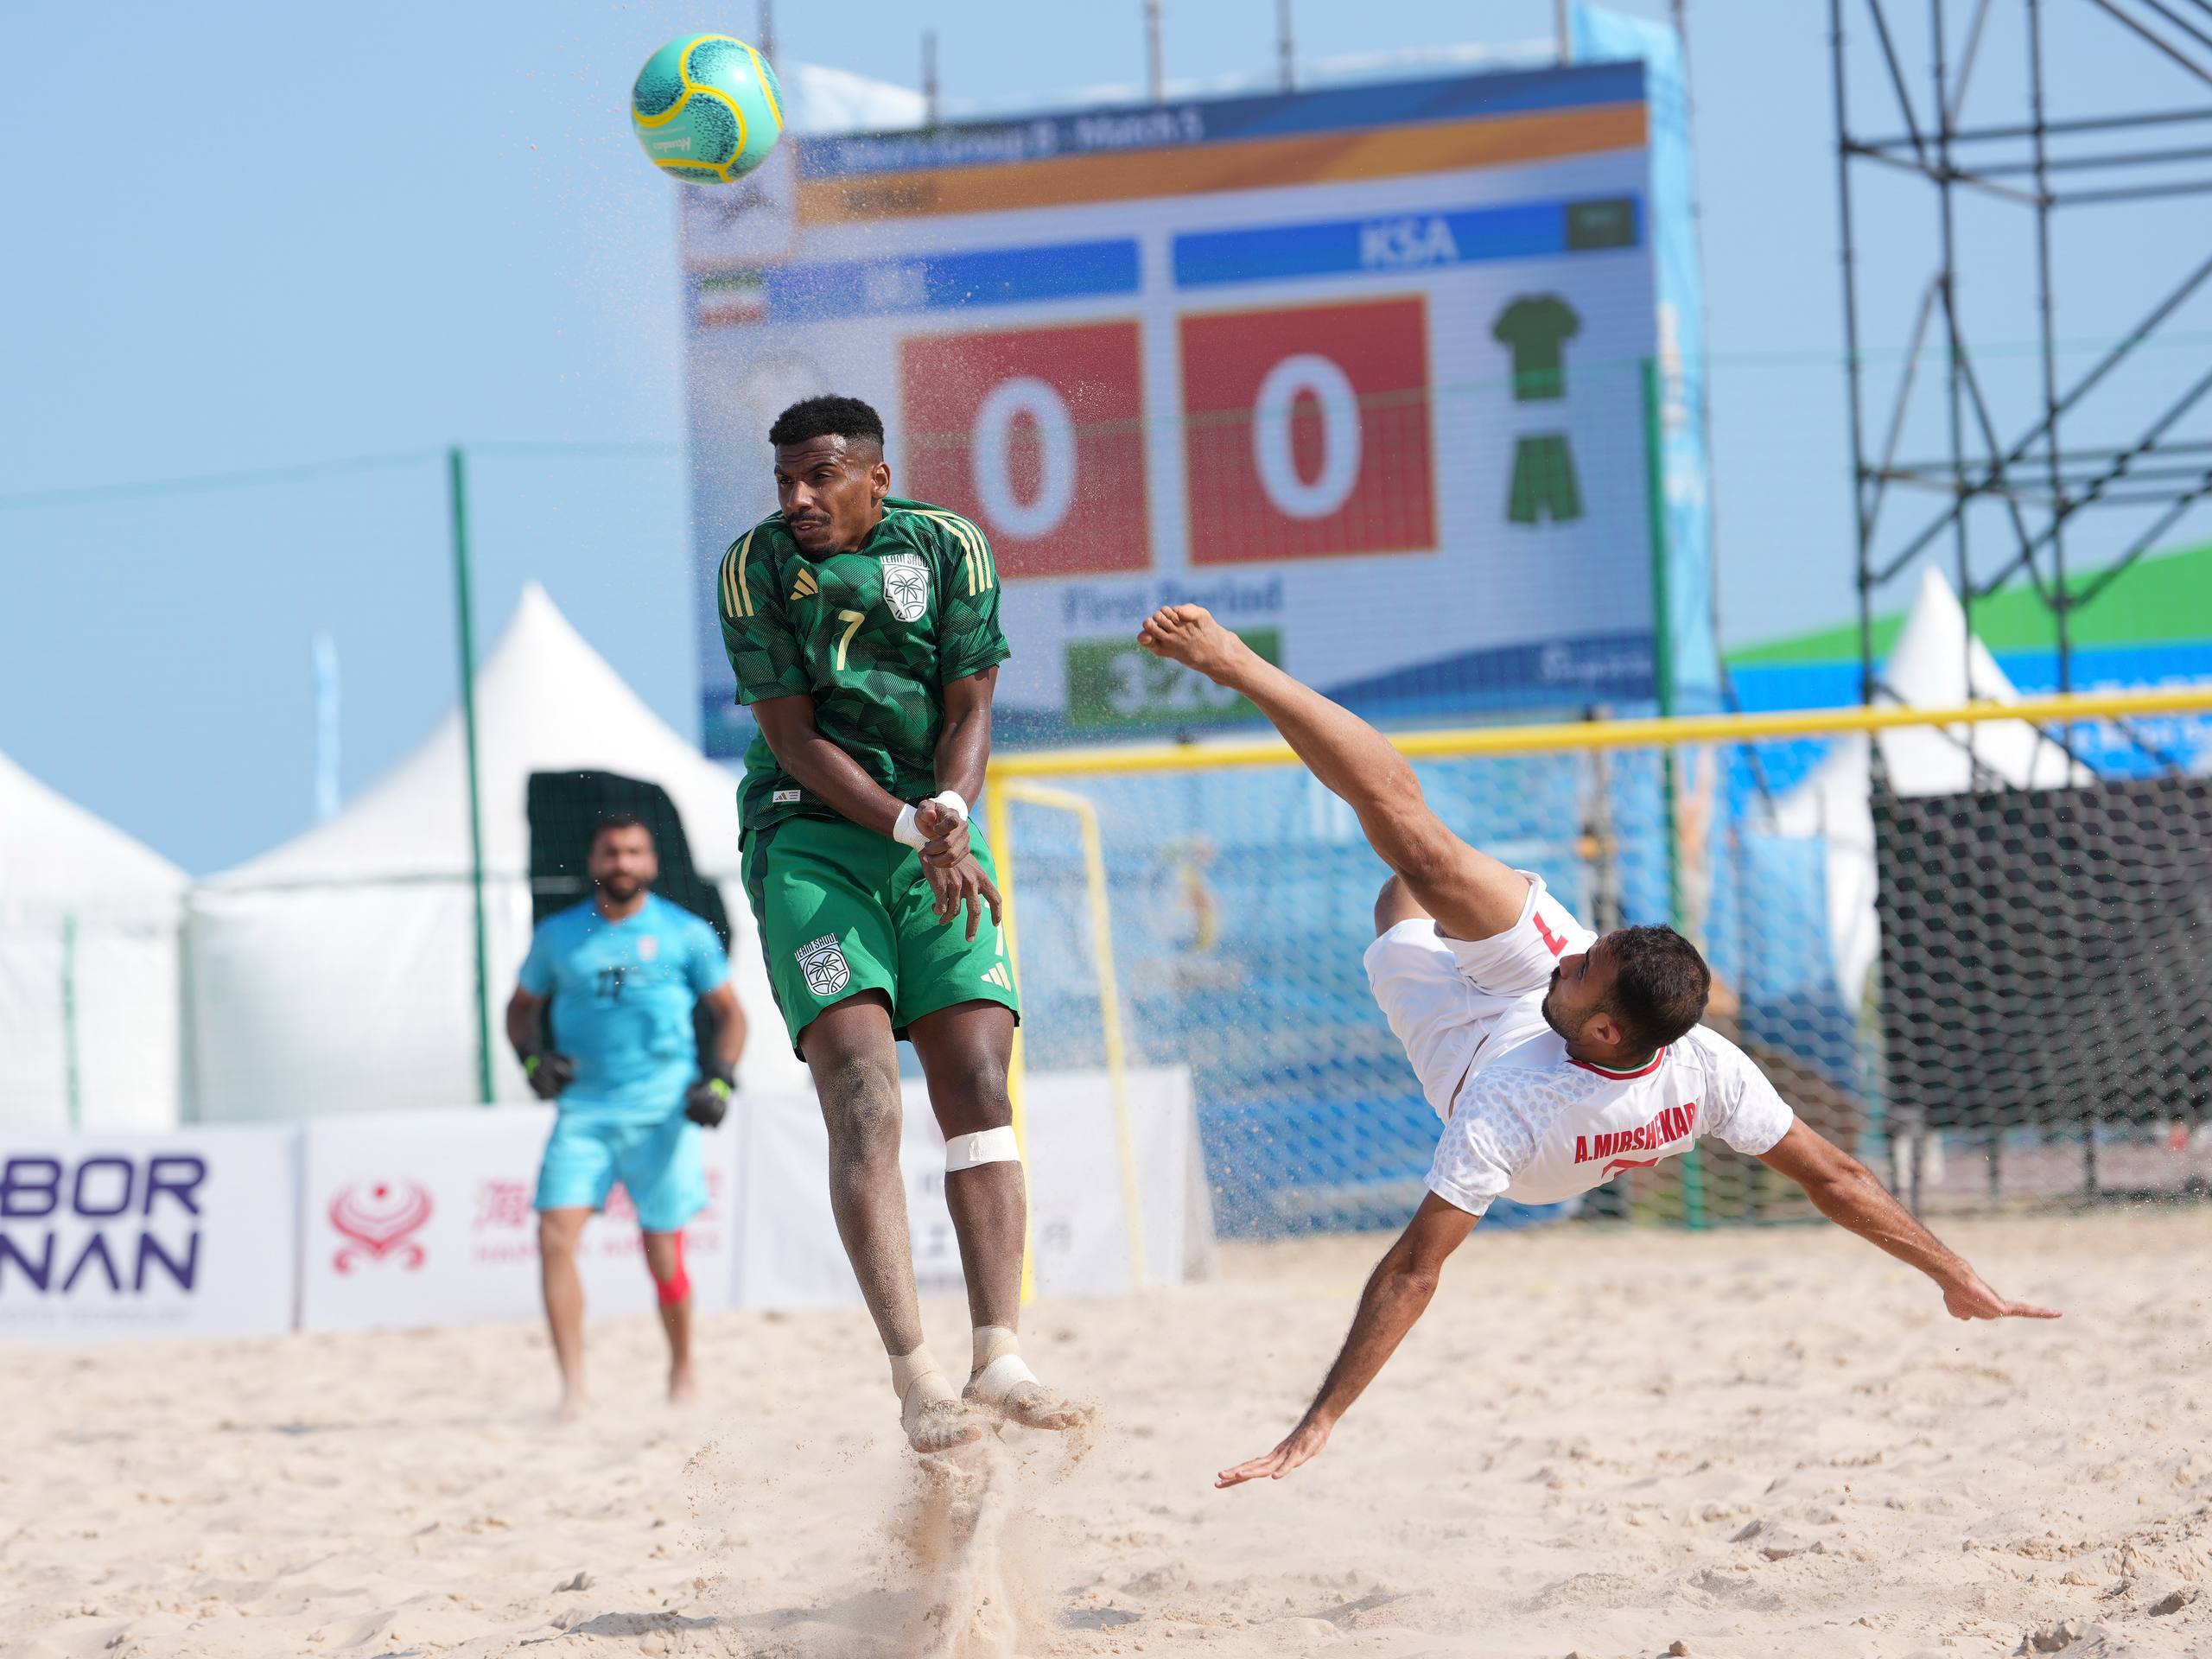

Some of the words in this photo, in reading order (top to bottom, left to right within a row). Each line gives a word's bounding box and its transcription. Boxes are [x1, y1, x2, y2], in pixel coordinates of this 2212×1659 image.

[1360, 217, 1460, 267] KSA
[974, 378, 1077, 539] 0
[1252, 353, 1362, 519] 0
[836, 609, 865, 671] 7
[795, 943, 815, 960] TEAM
[814, 932, 838, 949] SAUDI
[1574, 1098, 1700, 1164] A.MIRSHEKAR
